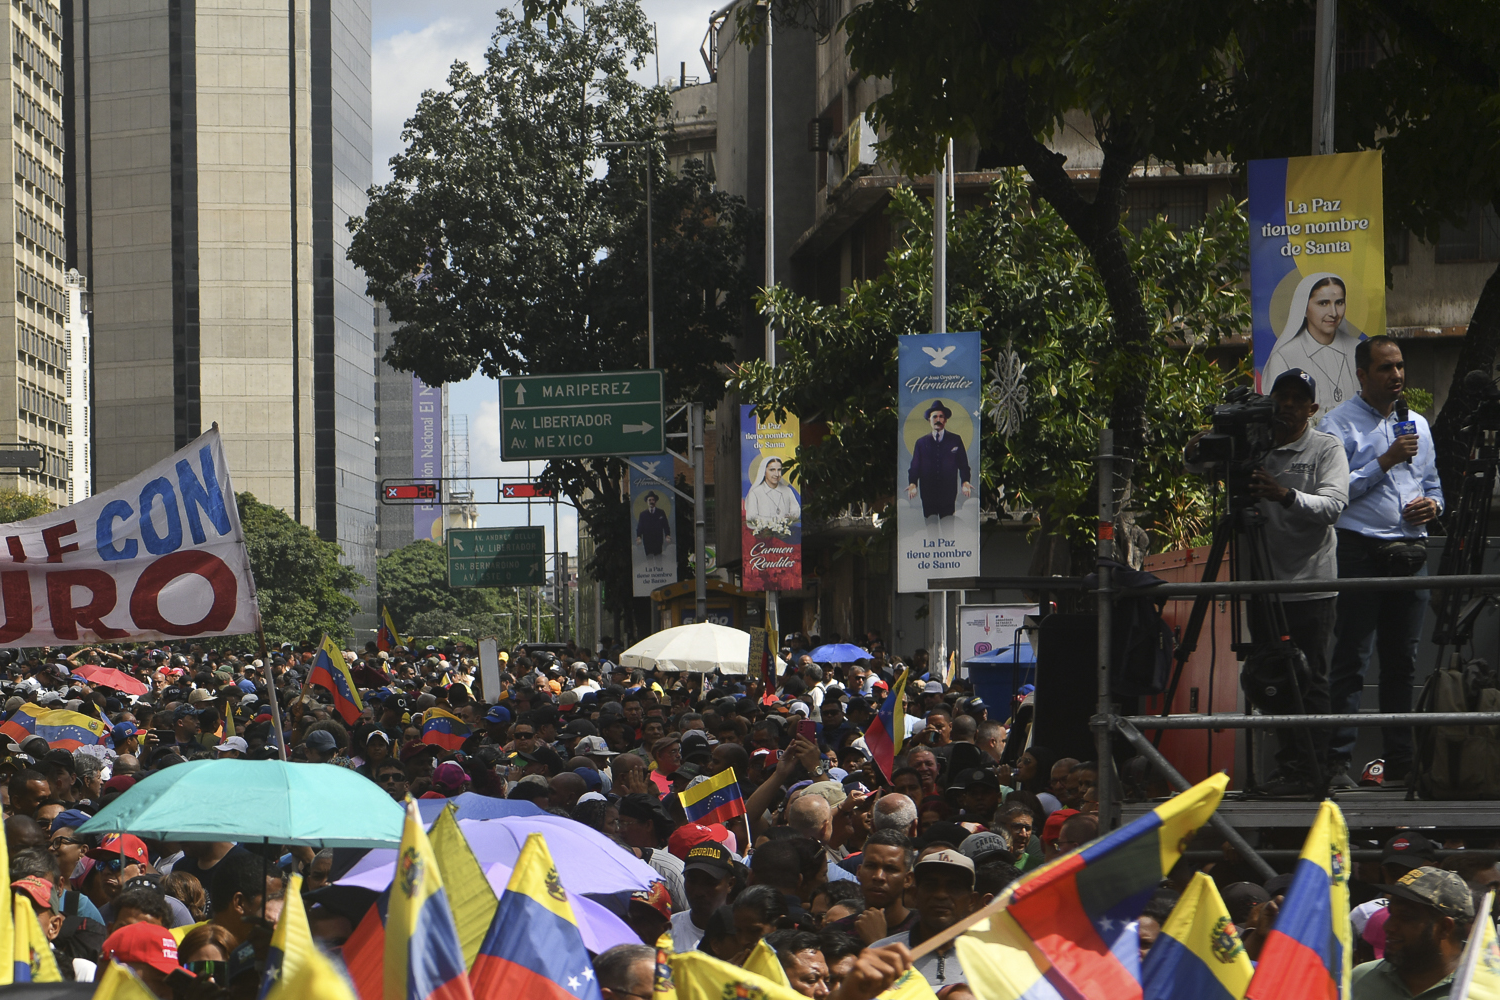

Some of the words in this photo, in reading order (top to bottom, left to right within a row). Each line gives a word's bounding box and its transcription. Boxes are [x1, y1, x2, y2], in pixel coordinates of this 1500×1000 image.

[1288, 200, 1308, 215] La
[1312, 198, 1341, 213] Paz
[1261, 222, 1301, 237] tiene
[1305, 217, 1369, 235] nombre
[1280, 242, 1301, 257] de
[1305, 240, 1351, 255] Santa
[542, 382, 631, 398] MARIPEREZ
[905, 377, 973, 392] Hernández
[419, 402, 434, 413] El
[533, 414, 612, 429] LIBERTADOR
[421, 417, 434, 458] Nacional
[534, 434, 593, 448] MEXICO
[765, 431, 793, 439] nombre
[419, 485, 435, 499] 26
[96, 444, 232, 562] CON
[750, 542, 794, 557] Carmen
[923, 539, 935, 548] La
[938, 538, 956, 547] Paz
[906, 550, 930, 559] tiene
[933, 549, 972, 558] nombre
[749, 556, 795, 571] Rendiles
[917, 561, 930, 569] de
[933, 560, 961, 569] Santo
[688, 847, 721, 859] SEGURIDAD
